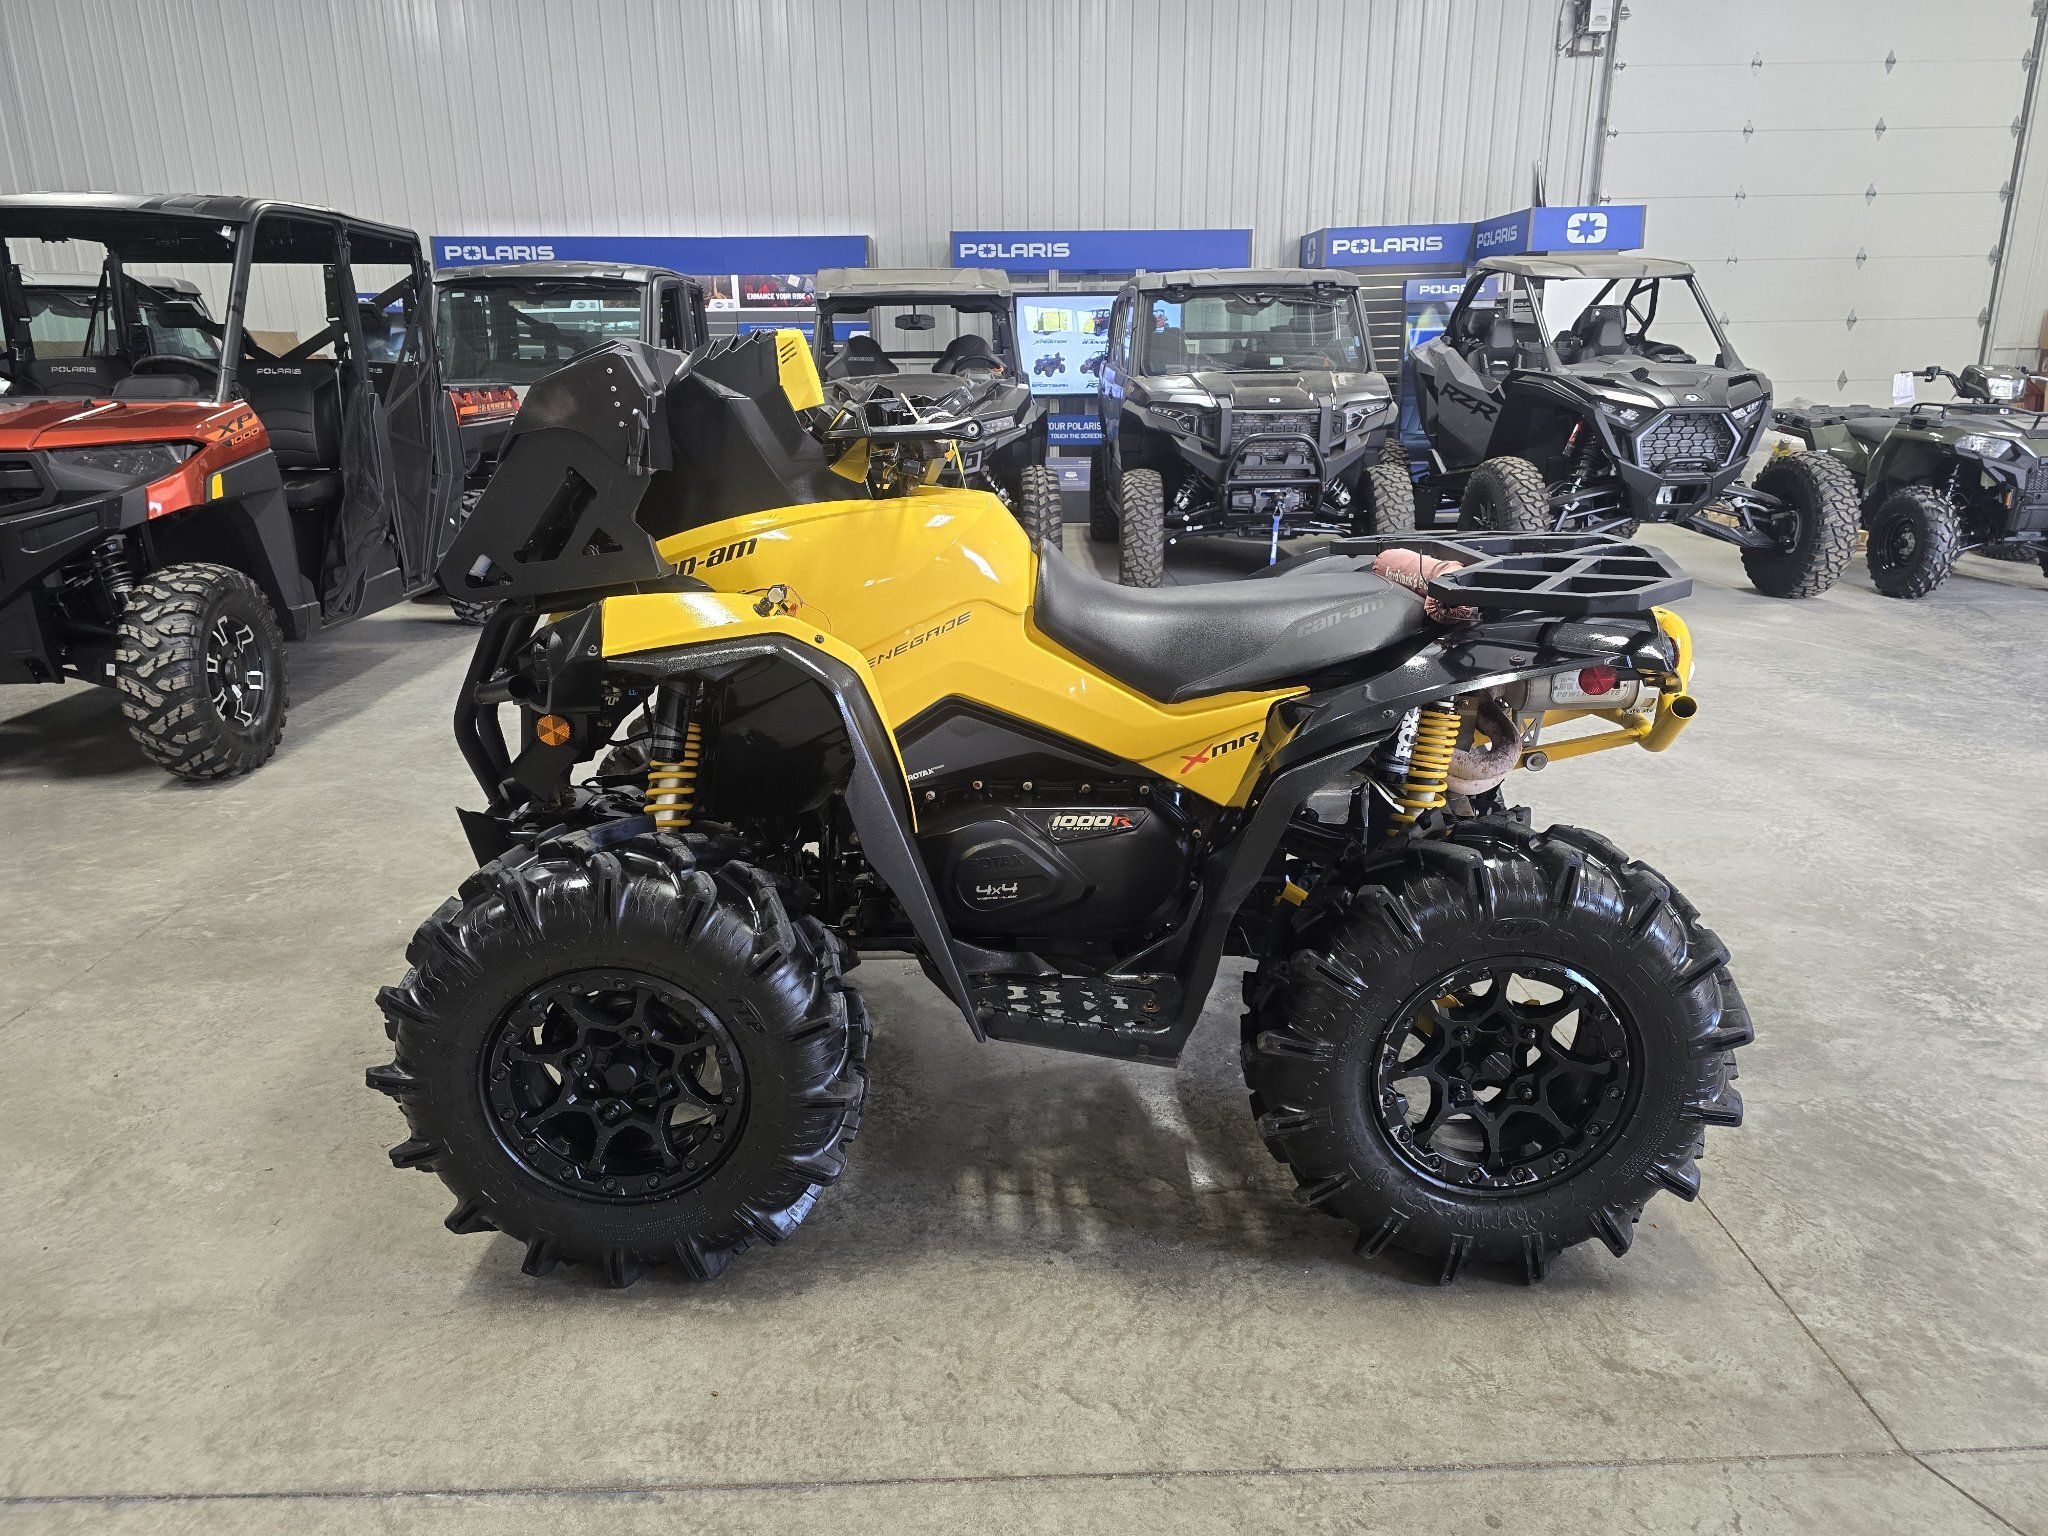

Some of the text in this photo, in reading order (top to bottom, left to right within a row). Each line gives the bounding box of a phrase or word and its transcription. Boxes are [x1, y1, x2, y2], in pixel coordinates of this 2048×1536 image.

[1332, 235, 1443, 255] POLARIS
[1476, 225, 1518, 249] POLARIS
[444, 245, 555, 261] POLARIS
[959, 242, 1071, 258] POLARIS
[746, 292, 807, 300] ENHANCE YOUR RIDE
[51, 366, 97, 374] POLARIS
[256, 367, 302, 375] POLARIS
[1439, 382, 1499, 423] RZR
[218, 412, 253, 440] XP
[1066, 421, 1102, 431] POLARIS
[230, 426, 260, 446] 1000
[673, 537, 758, 576] n-am
[1296, 599, 1385, 639] can-am
[867, 610, 972, 669] ENEGADE
[1394, 706, 1421, 759] FOX
[907, 767, 935, 782] ROTAX
[1051, 815, 1134, 828] 1000R
[975, 882, 1019, 896] 4x4
